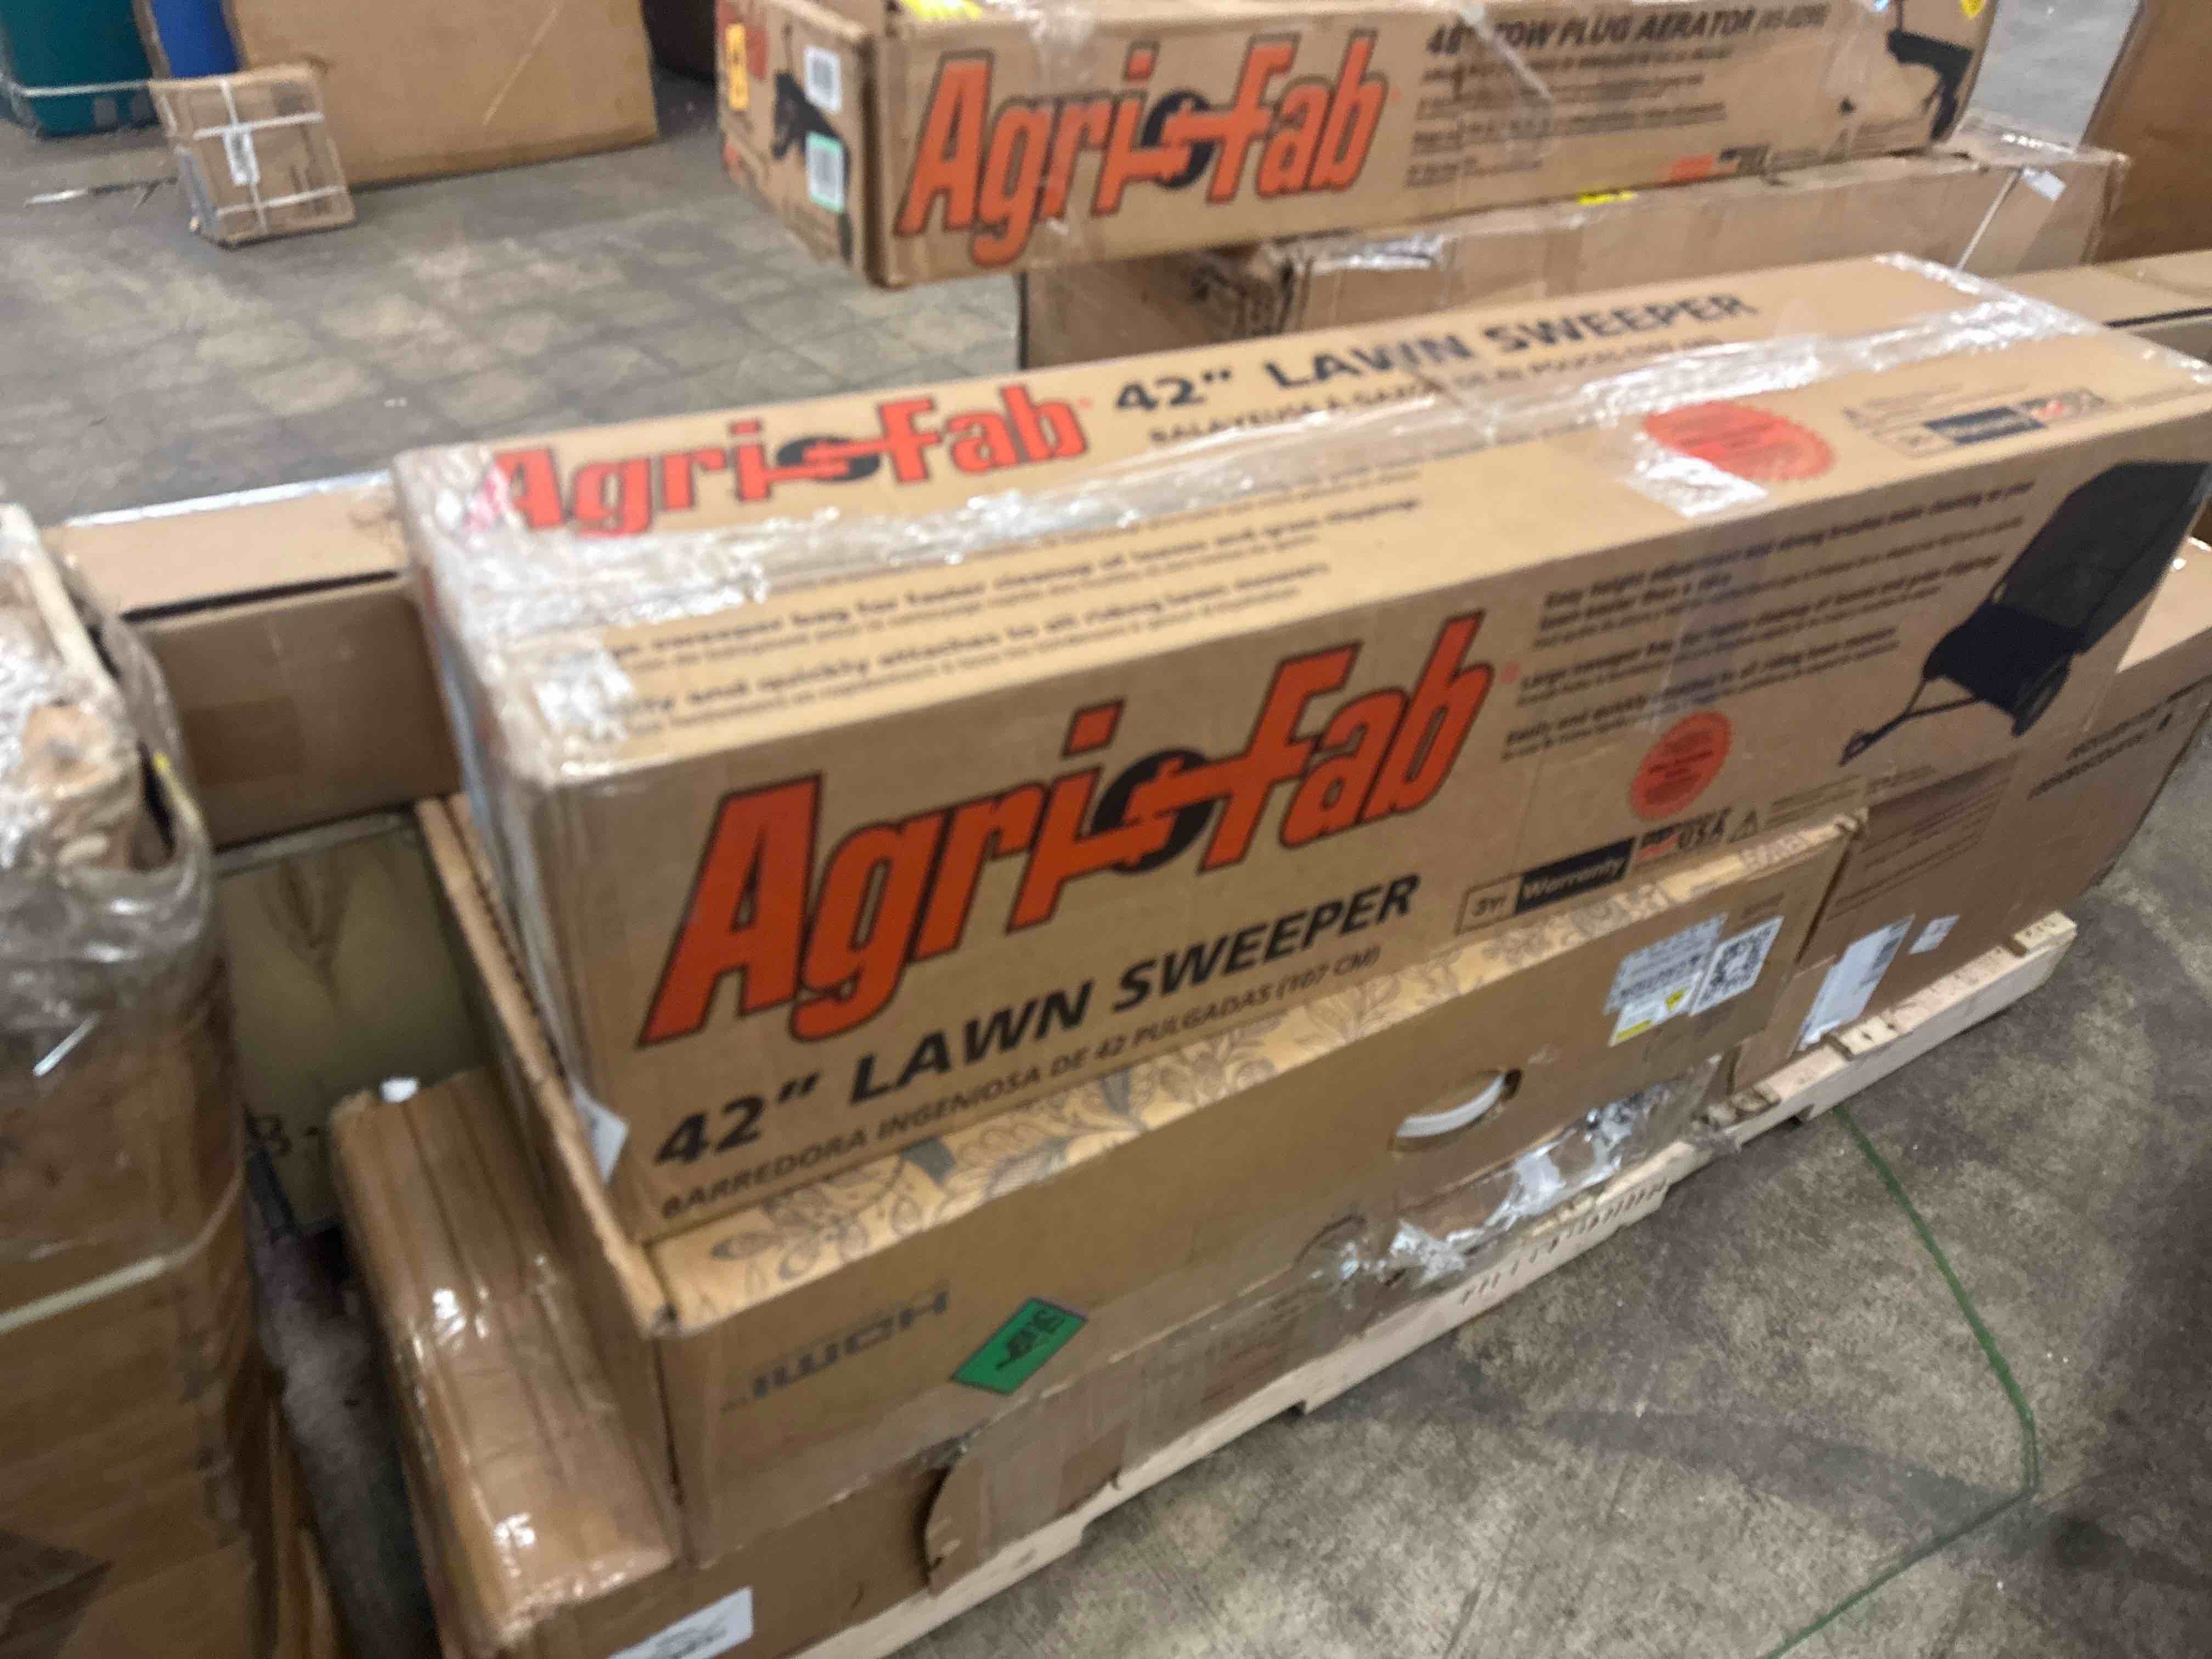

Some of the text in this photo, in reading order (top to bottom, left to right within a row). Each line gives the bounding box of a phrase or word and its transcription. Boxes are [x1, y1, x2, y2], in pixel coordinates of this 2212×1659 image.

[1115, 369, 1233, 411] 42"
[1482, 292, 1759, 352] SWEEPER
[653, 871, 1423, 1165] 42" LAWN SWEEPER
[661, 1127, 868, 1220] BARREDORA
[876, 1065, 1041, 1141] INGENIOSA
[1049, 1045, 1092, 1077] DE
[1093, 1035, 1126, 1061] 42
[1132, 982, 1273, 1046] PULGADAS
